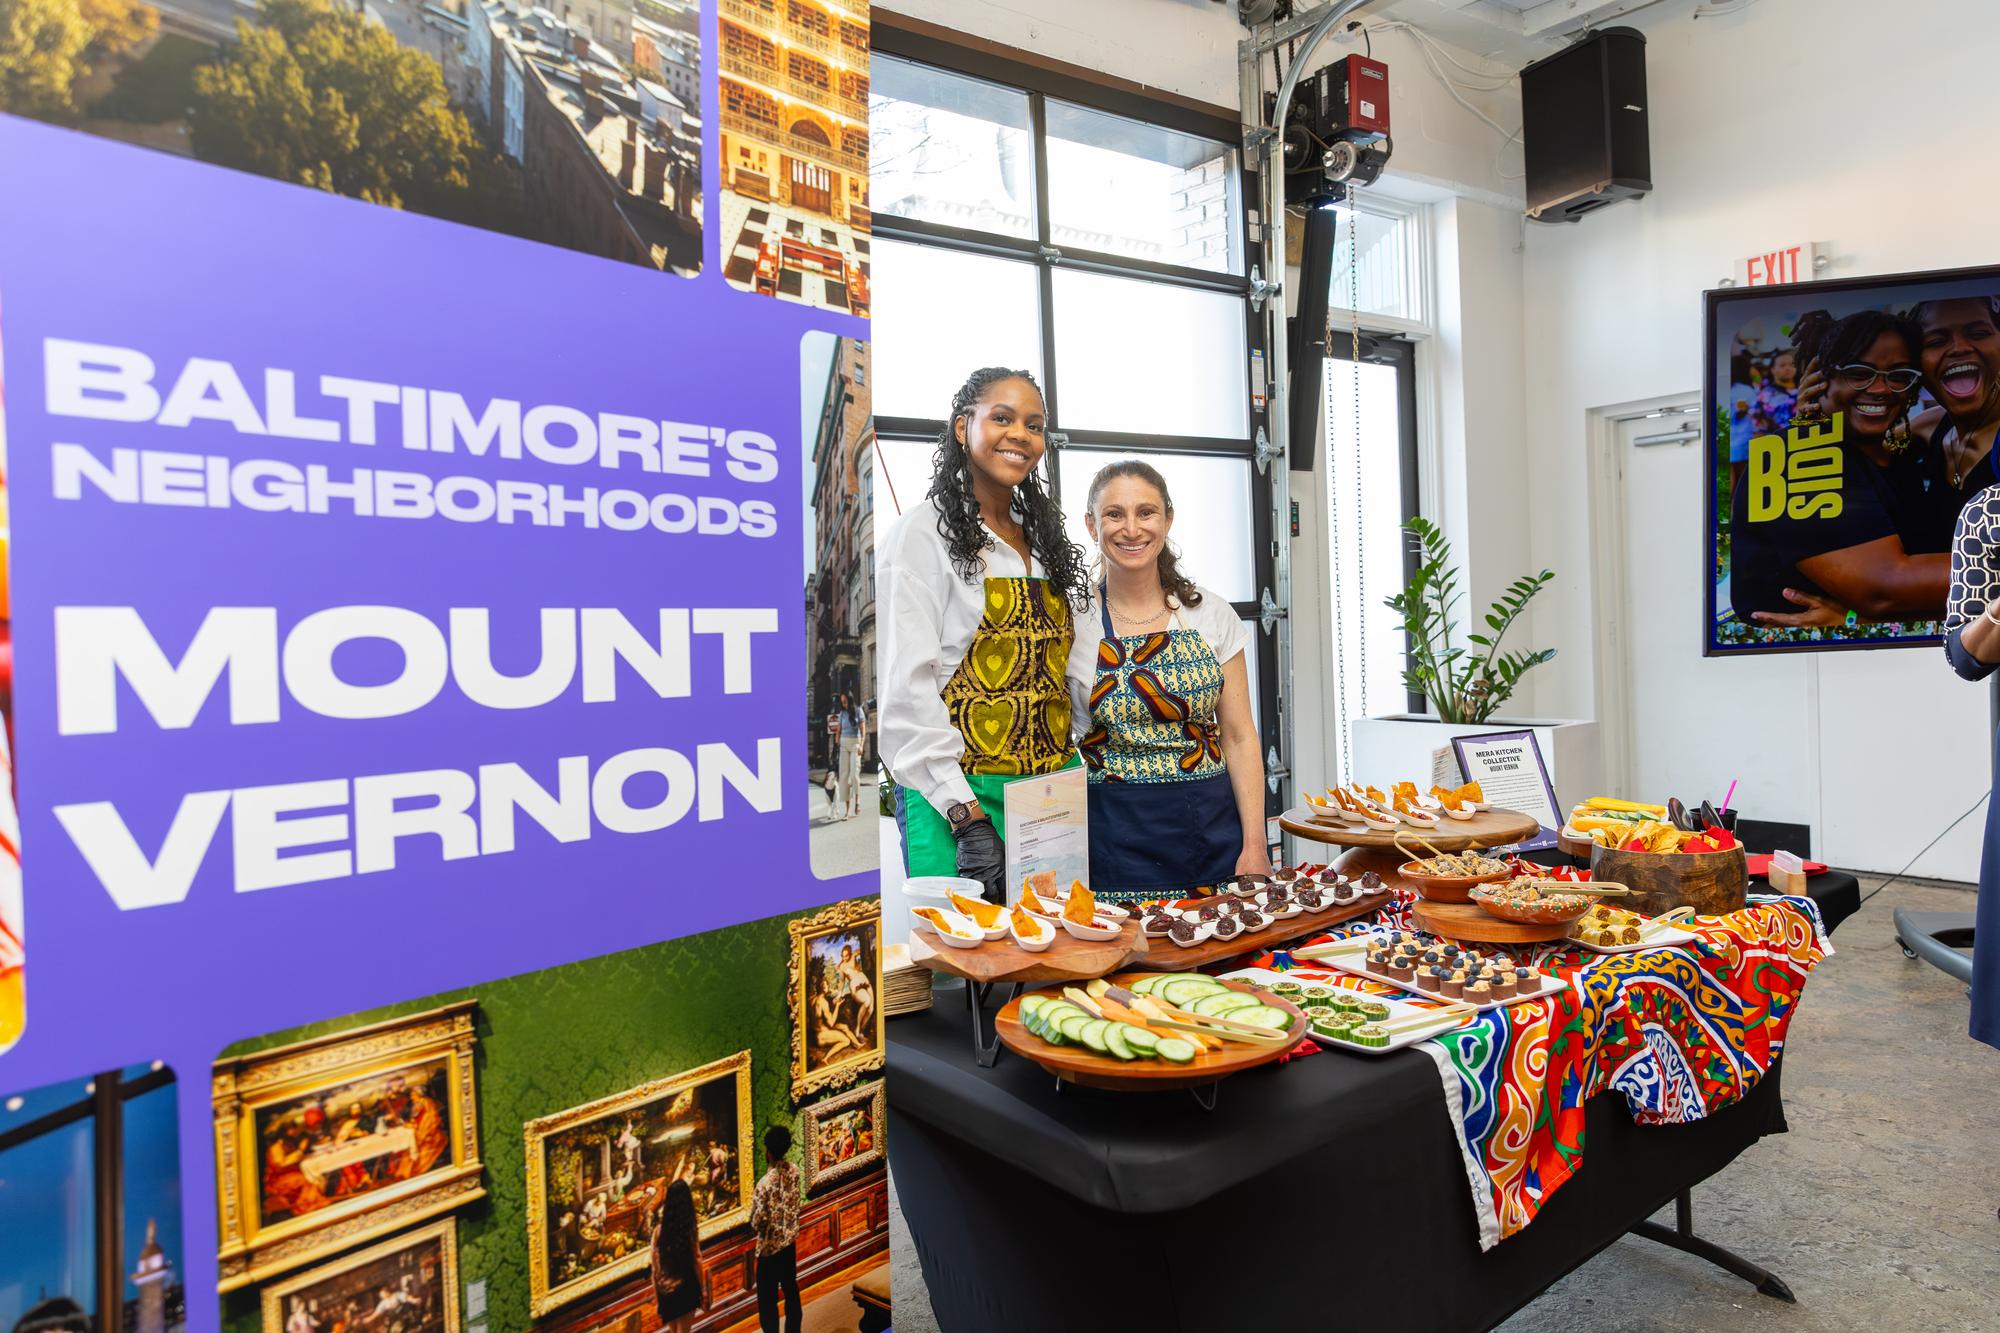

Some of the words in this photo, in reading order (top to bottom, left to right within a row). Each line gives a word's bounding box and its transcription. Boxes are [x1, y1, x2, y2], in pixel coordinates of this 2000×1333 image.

[1747, 246, 1801, 288] EXIT
[44, 338, 778, 483] BALTIMORE'S
[52, 443, 778, 538] NEIGHBORHOODS
[1748, 434, 1787, 523] B
[1787, 411, 1844, 520] SIDE
[54, 605, 779, 736] MOUNT
[1475, 749, 1495, 758] MERA
[1496, 747, 1523, 756] KITCHEN
[1482, 755, 1521, 765] COLLECTIVE
[53, 737, 782, 911] VERNON
